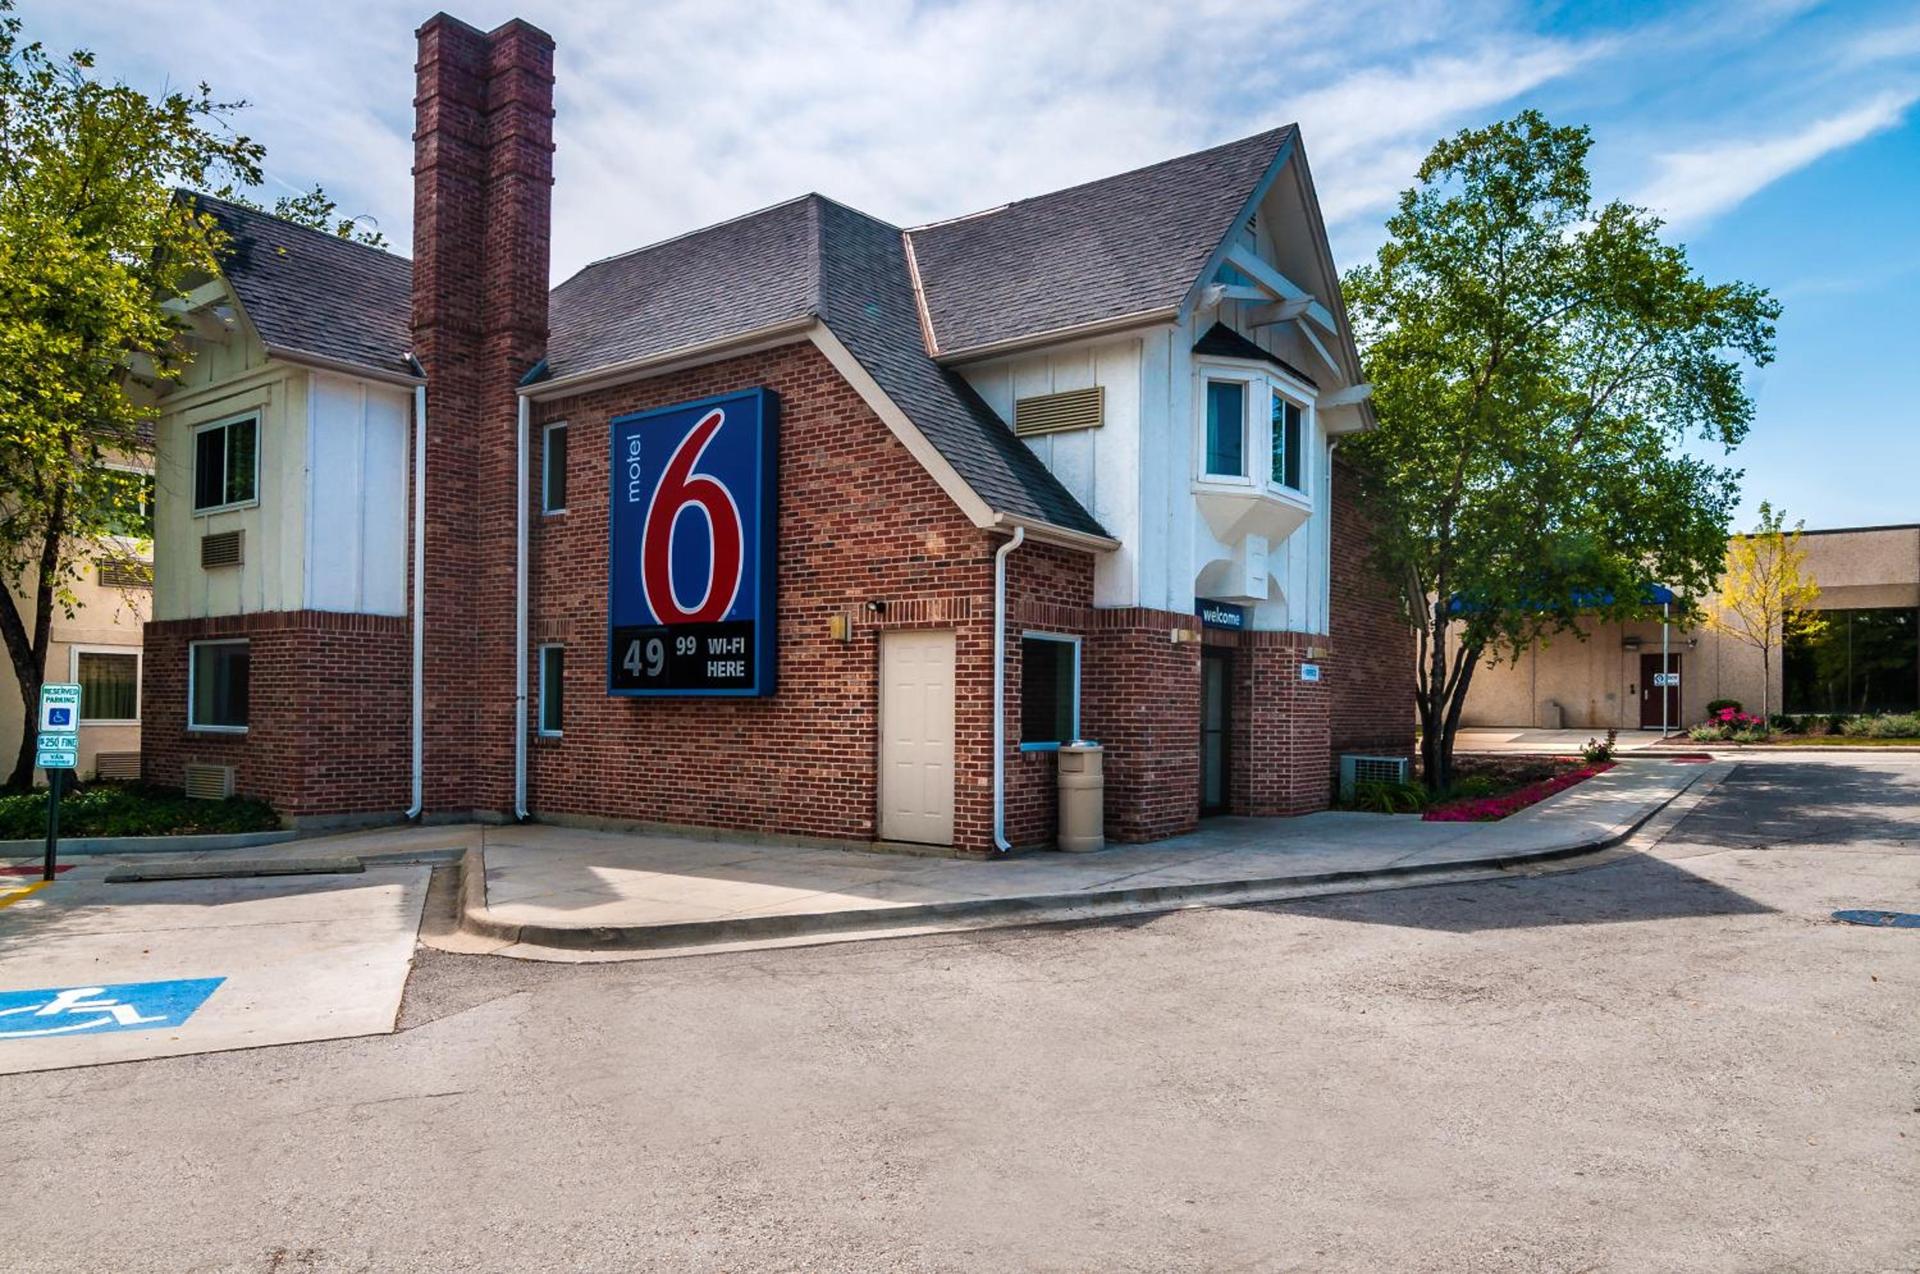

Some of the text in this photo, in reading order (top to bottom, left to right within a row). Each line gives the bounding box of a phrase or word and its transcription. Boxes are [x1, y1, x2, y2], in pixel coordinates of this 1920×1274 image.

[626, 433, 642, 503] motel
[640, 407, 745, 626] 6
[1203, 606, 1240, 626] welcome
[707, 637, 745, 655] WI-FI
[623, 636, 697, 677] 49 99
[707, 661, 745, 678] HERE
[43, 688, 79, 696] RESERVED
[61, 737, 77, 748] FINE
